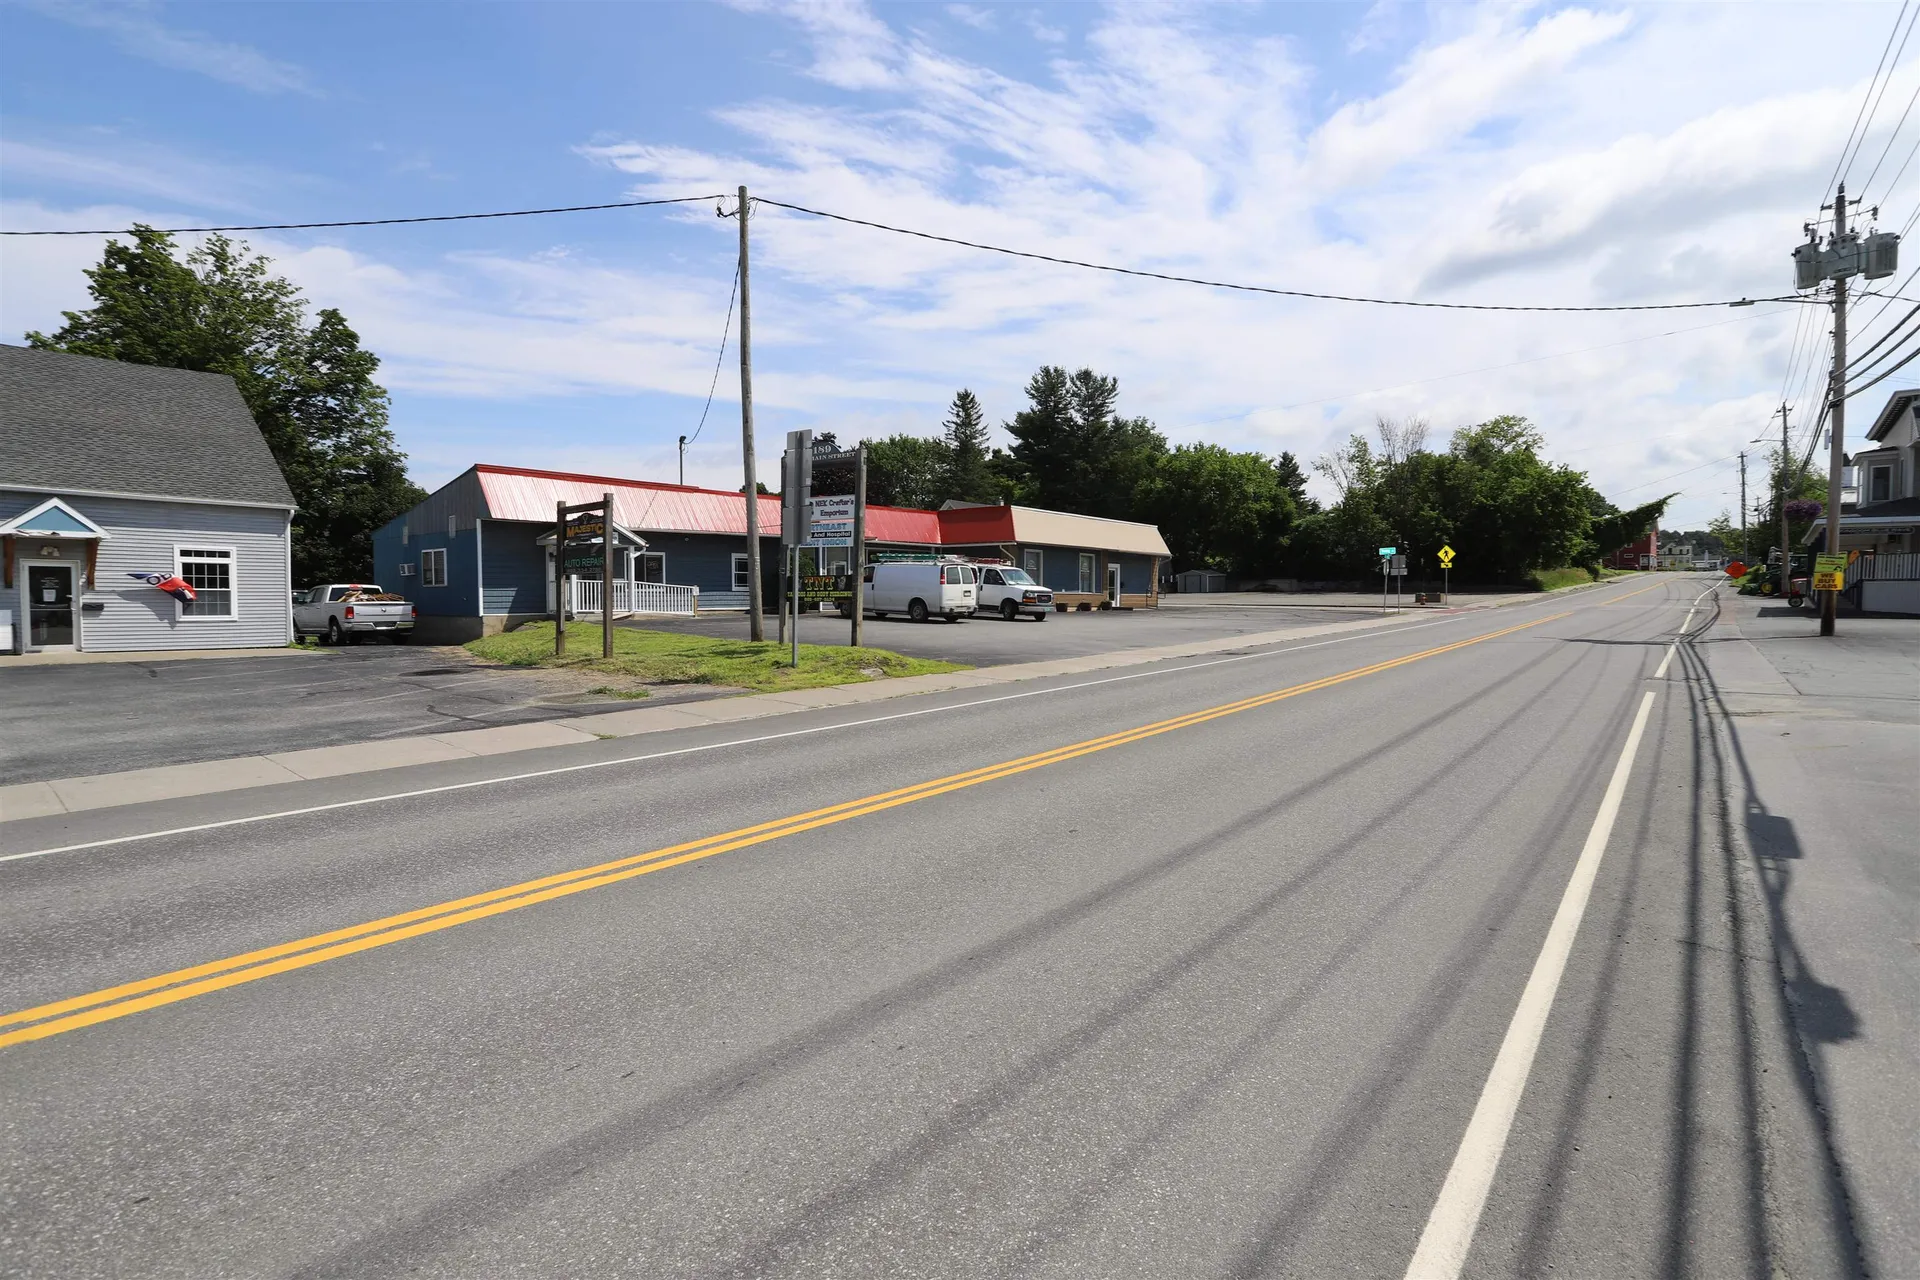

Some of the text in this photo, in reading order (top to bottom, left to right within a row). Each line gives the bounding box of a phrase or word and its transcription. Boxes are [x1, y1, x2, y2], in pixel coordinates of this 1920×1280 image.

[814, 445, 832, 454] 189
[566, 523, 604, 538] MAJESTIC
[822, 538, 847, 546] UNION
[564, 557, 604, 568] AUTO REPAIR
[804, 576, 835, 590] TNT
